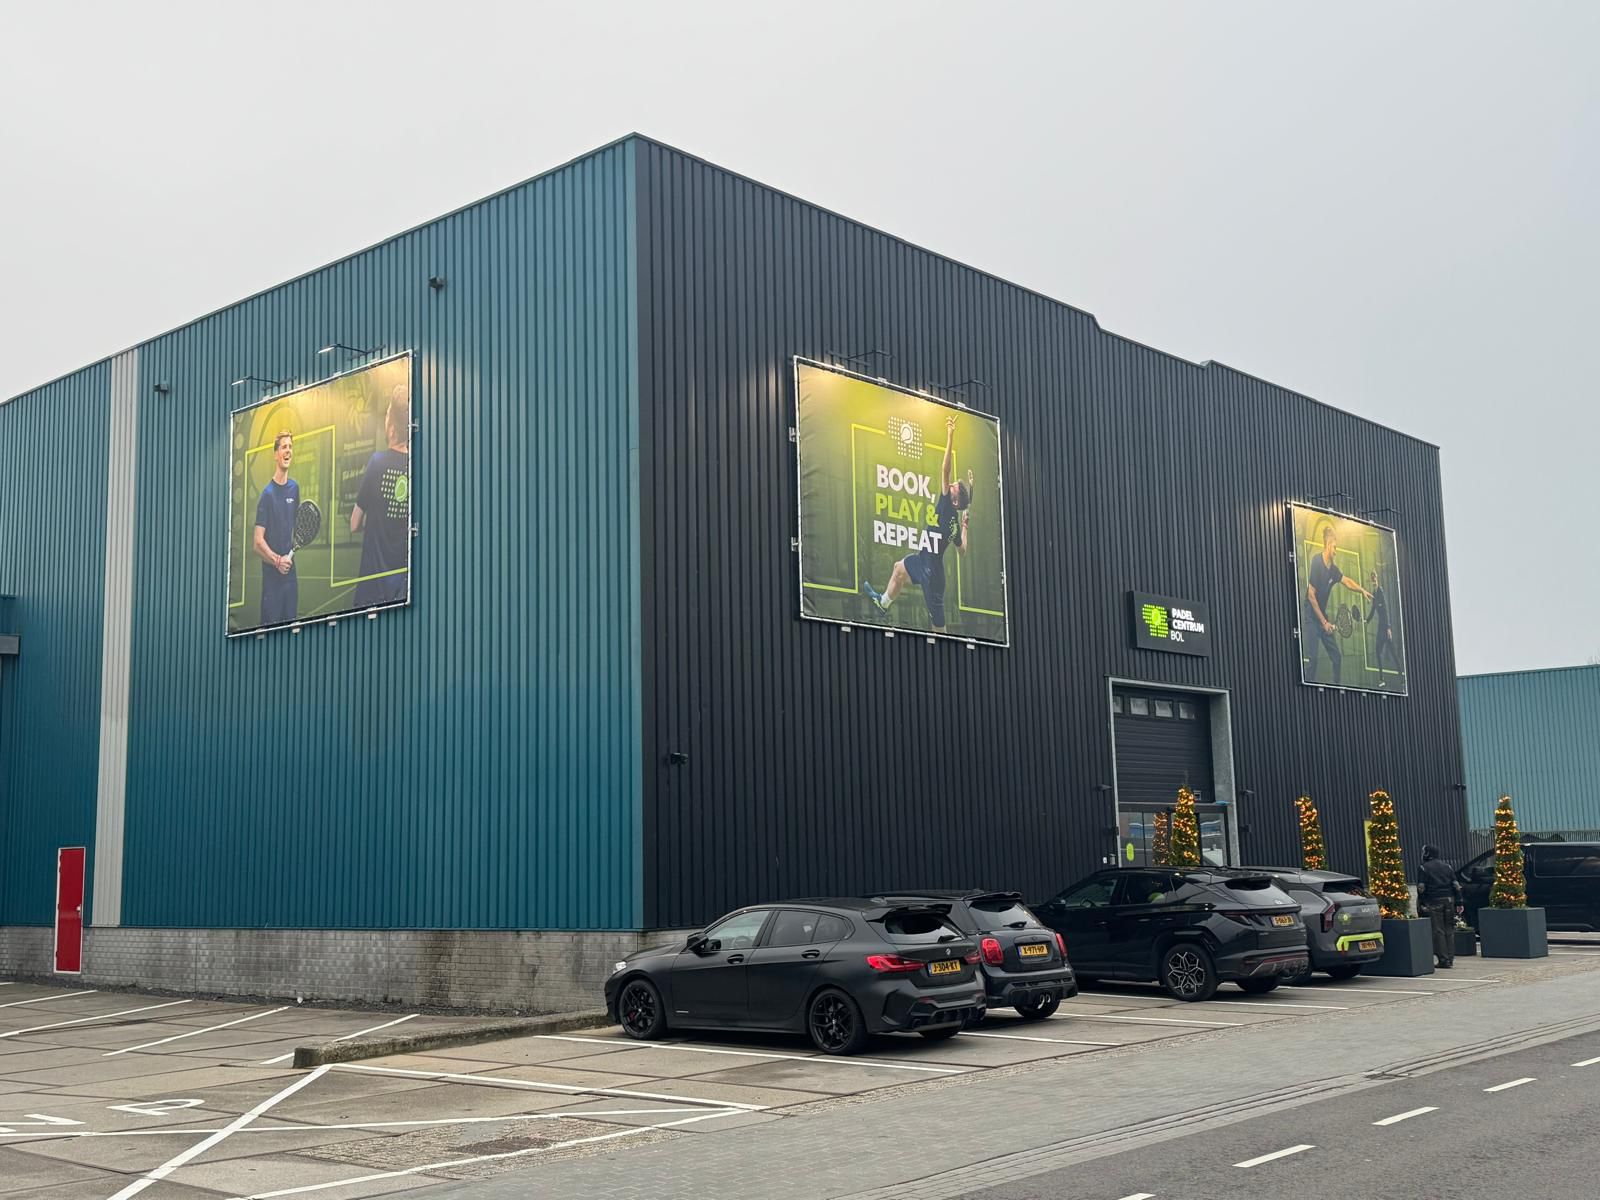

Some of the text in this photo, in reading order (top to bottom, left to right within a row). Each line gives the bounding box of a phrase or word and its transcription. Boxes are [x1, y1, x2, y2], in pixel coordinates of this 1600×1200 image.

[876, 464, 936, 503] BOOK,
[875, 492, 940, 527] PLAY &
[873, 520, 942, 554] REPEAT
[1171, 607, 1195, 621] PADEL
[1172, 618, 1205, 633] CENTRUM
[1170, 630, 1185, 642] BOL
[933, 959, 958, 972] J-304-KT
